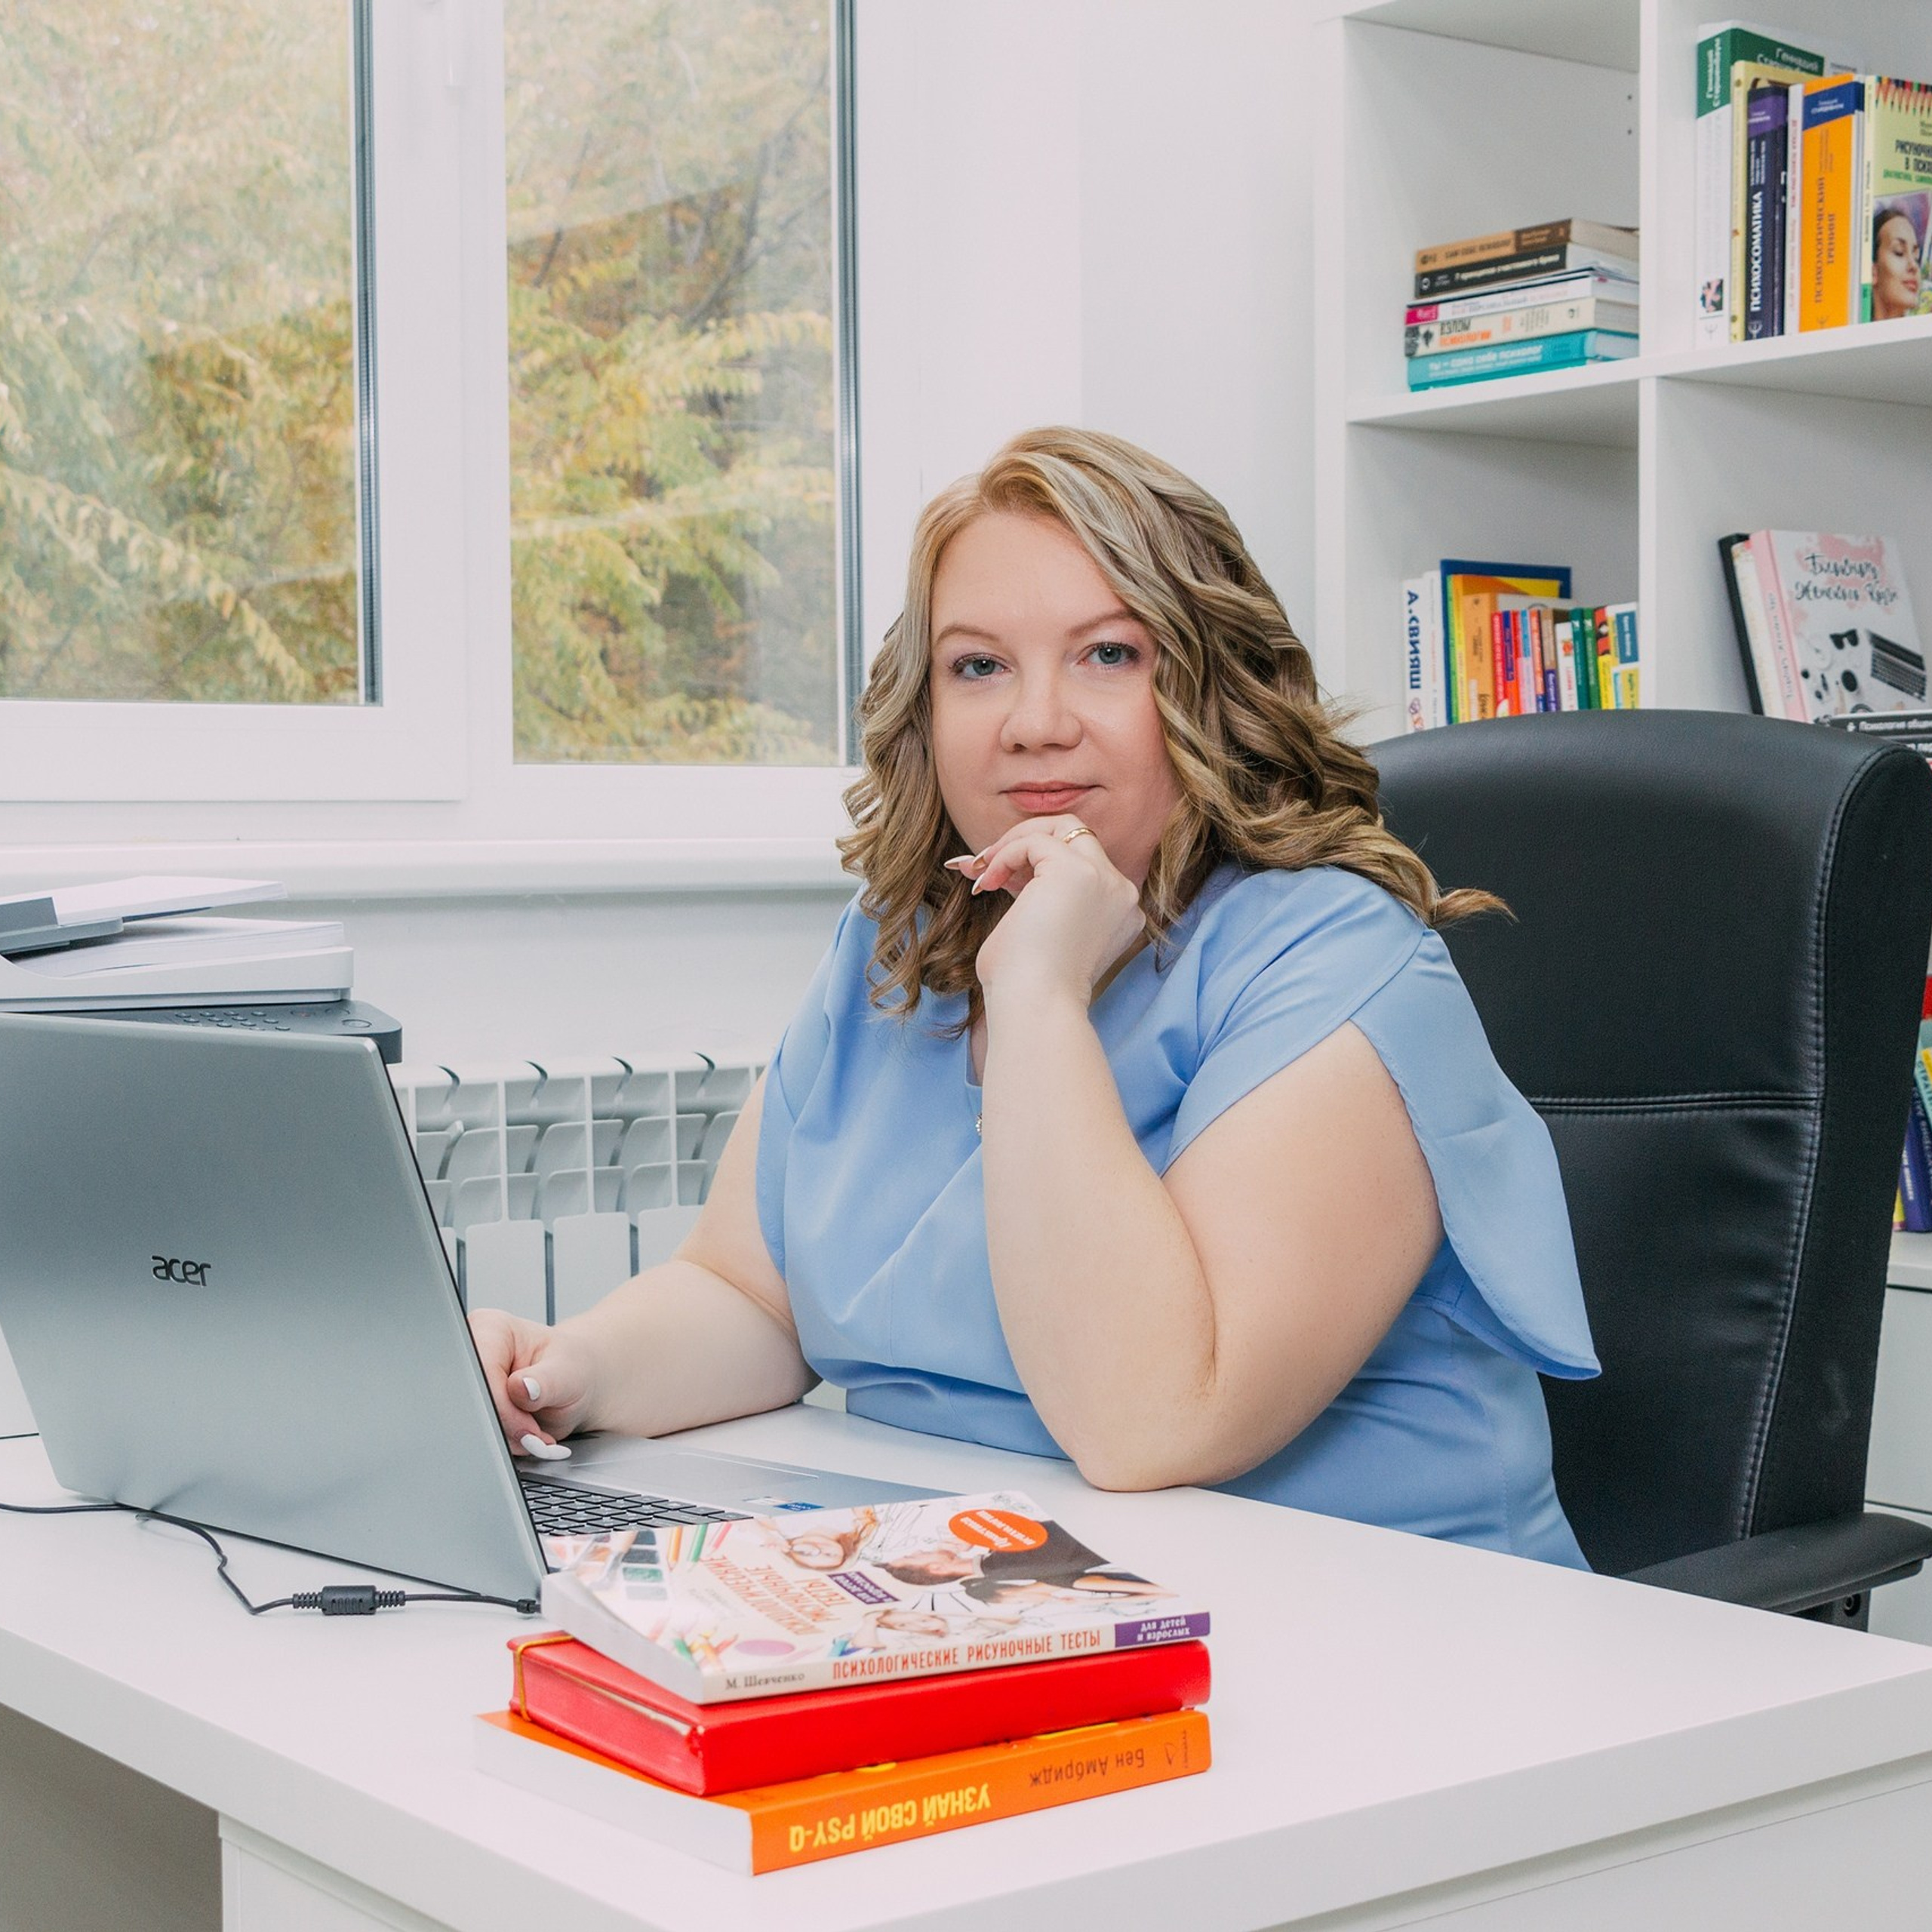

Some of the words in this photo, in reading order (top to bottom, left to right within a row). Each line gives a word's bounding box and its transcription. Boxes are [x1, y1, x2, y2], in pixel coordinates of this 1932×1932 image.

[1749, 190, 1763, 312] ПСИХОСОМАТИКА
[1816, 177, 1826, 303] ПСИХОЛОГИЧЕСКИЙ
[152, 1255, 211, 1287] acer
[699, 1555, 825, 1635] ПСИХОЛОГИЧЕСКИЕ
[794, 1579, 852, 1606] ТЕСТЫ
[1140, 1620, 1157, 1632] для
[1160, 1616, 1186, 1629] детей
[1146, 1627, 1190, 1642] взрослых
[725, 1678, 740, 1690] М.
[743, 1671, 805, 1689] Шевченко
[832, 1647, 960, 1680] ПСИХОЛОГИЧЕСКИЕ
[967, 1638, 1053, 1662] РИСУНОЧНЫЕ
[1060, 1630, 1101, 1651] ТЕСТЫ
[1029, 1756, 1109, 1787] Амбридж
[1115, 1748, 1146, 1769] Бен
[862, 1800, 915, 1841] СВОЙ
[922, 1783, 992, 1828] УЗНАЙ
[789, 1813, 855, 1851] PSY-Q
